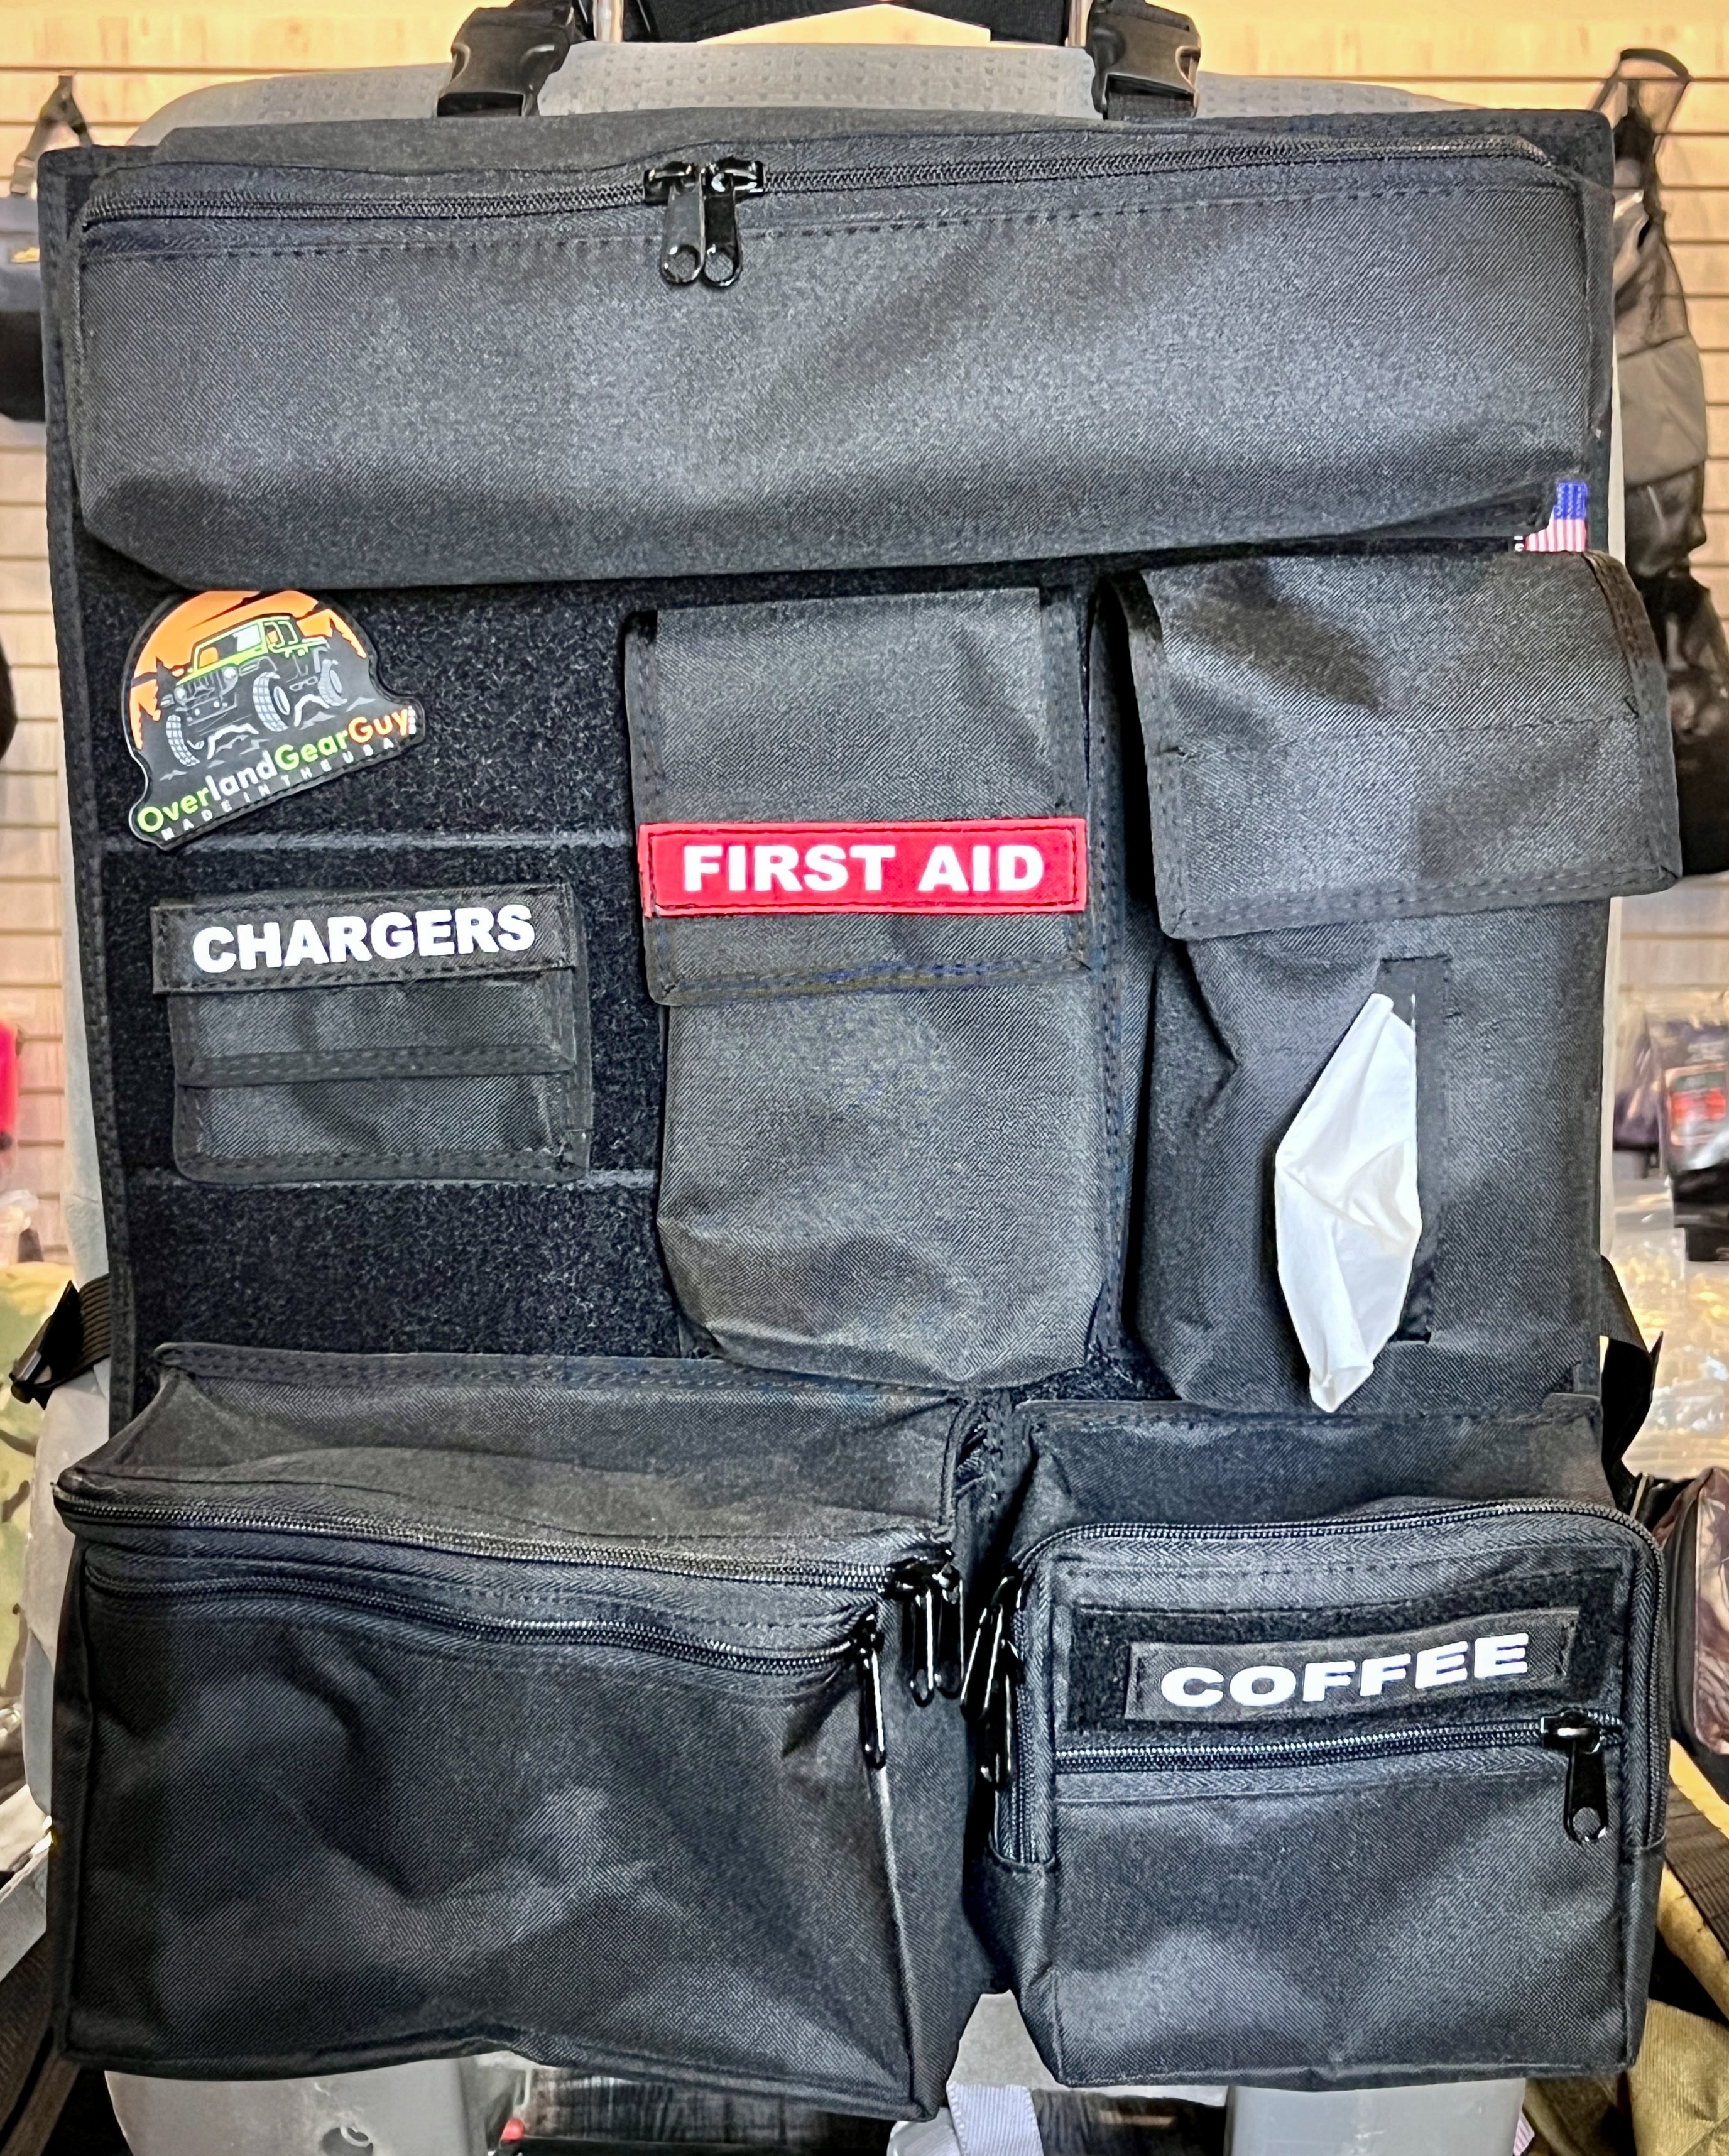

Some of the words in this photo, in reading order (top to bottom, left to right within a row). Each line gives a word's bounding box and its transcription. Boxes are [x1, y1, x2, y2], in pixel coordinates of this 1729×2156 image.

[136, 708, 408, 834] OverlandGearGuy
[161, 799, 233, 841] MADE
[243, 783, 271, 803] IN
[281, 759, 332, 787] THE
[342, 737, 395, 764] USA
[683, 844, 897, 893] FIRST
[917, 844, 1045, 893] AID
[192, 903, 535, 973] CHARGERS
[1160, 1632, 1529, 1707] COFFEE
